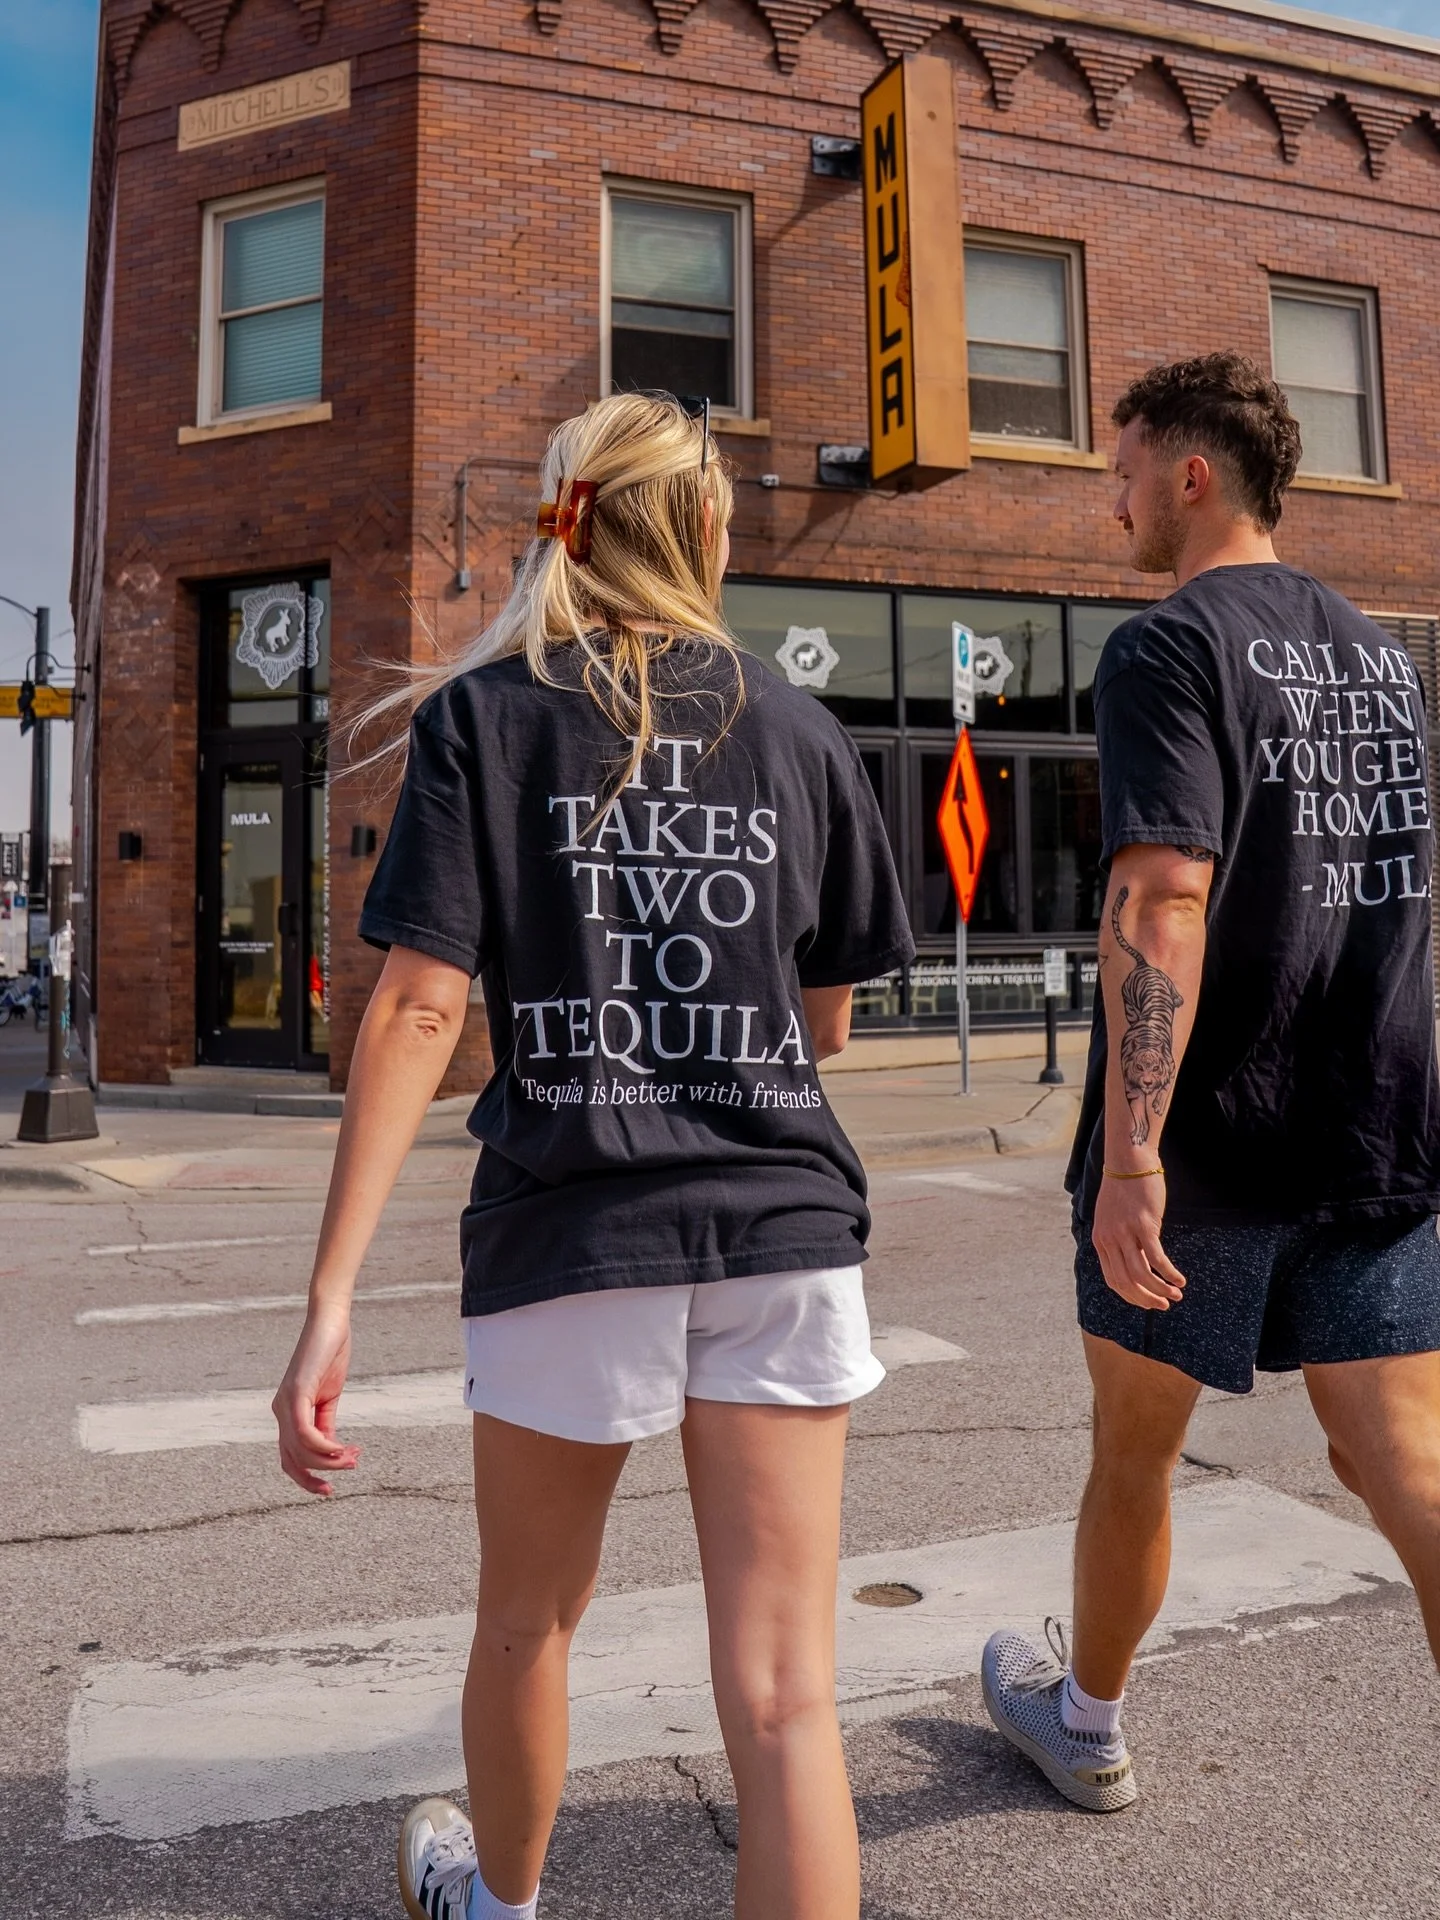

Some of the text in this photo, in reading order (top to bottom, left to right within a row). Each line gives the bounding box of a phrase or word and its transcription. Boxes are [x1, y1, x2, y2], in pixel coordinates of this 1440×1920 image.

[197, 75, 330, 135] MITCHELL'S
[874, 111, 905, 437] MULA
[1247, 638, 1418, 691] CALL ME
[1280, 687, 1415, 735] WHEN
[624, 735, 703, 793] IT
[1260, 736, 1425, 786] YOU GE
[230, 812, 271, 826] MULA
[548, 794, 778, 864] TAKES
[1292, 787, 1431, 837] HOME
[572, 860, 756, 928] TWO
[1320, 854, 1432, 908] MUL
[605, 930, 713, 993] TO
[951, 973, 991, 986] KCHEN
[513, 998, 809, 1074] TEQUILA
[588, 1079, 606, 1105] is
[610, 1078, 684, 1105] better
[689, 1082, 742, 1107] with
[749, 1082, 822, 1109] friends
